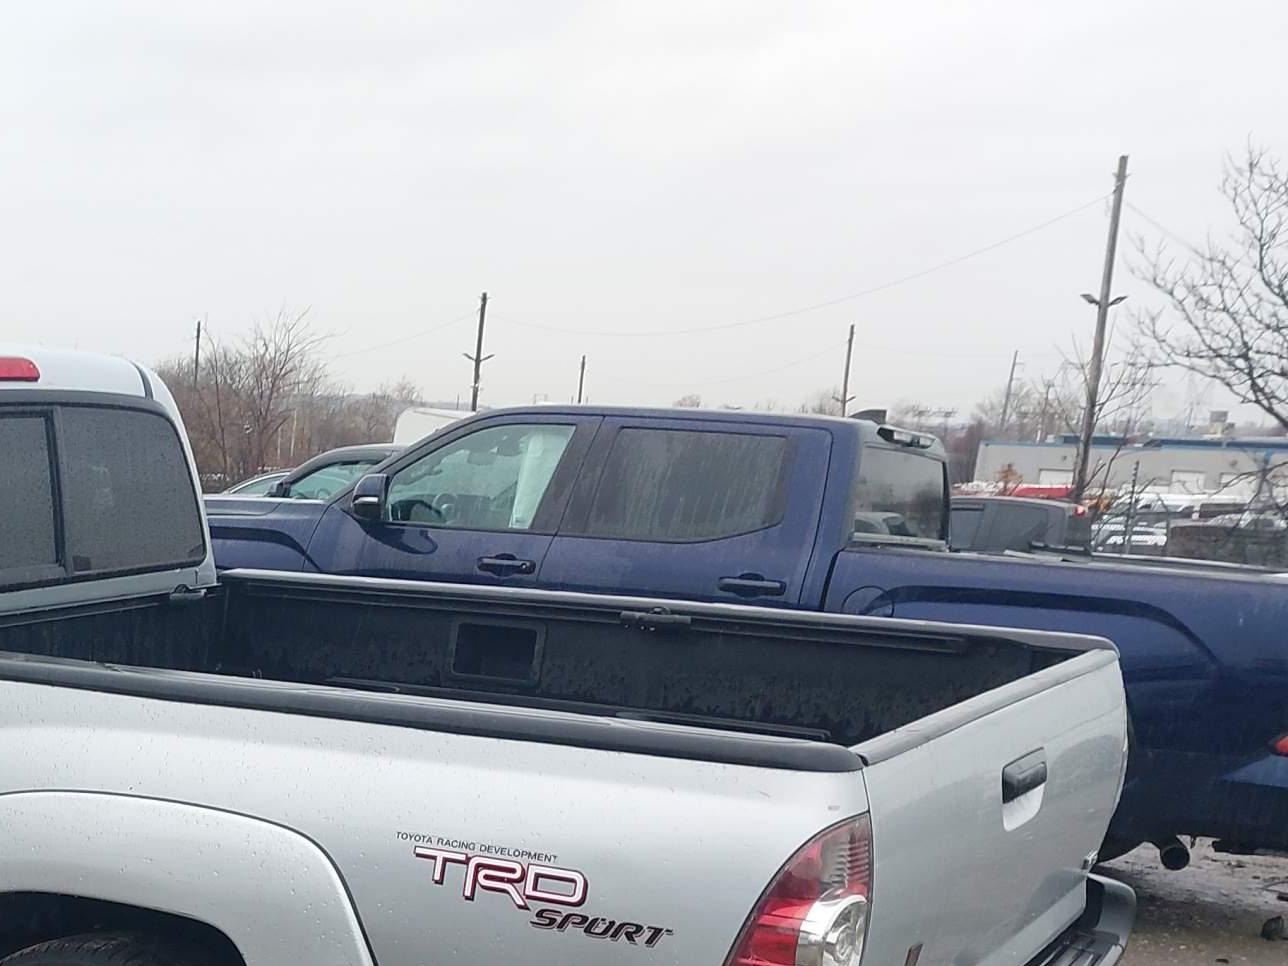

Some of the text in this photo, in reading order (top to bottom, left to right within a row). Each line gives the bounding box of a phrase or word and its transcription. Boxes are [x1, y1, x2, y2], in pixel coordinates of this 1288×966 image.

[396, 831, 559, 863] TOYOTA RACING DEVELOPMENT
[413, 846, 588, 911] TRD
[530, 908, 665, 948] SPORT
